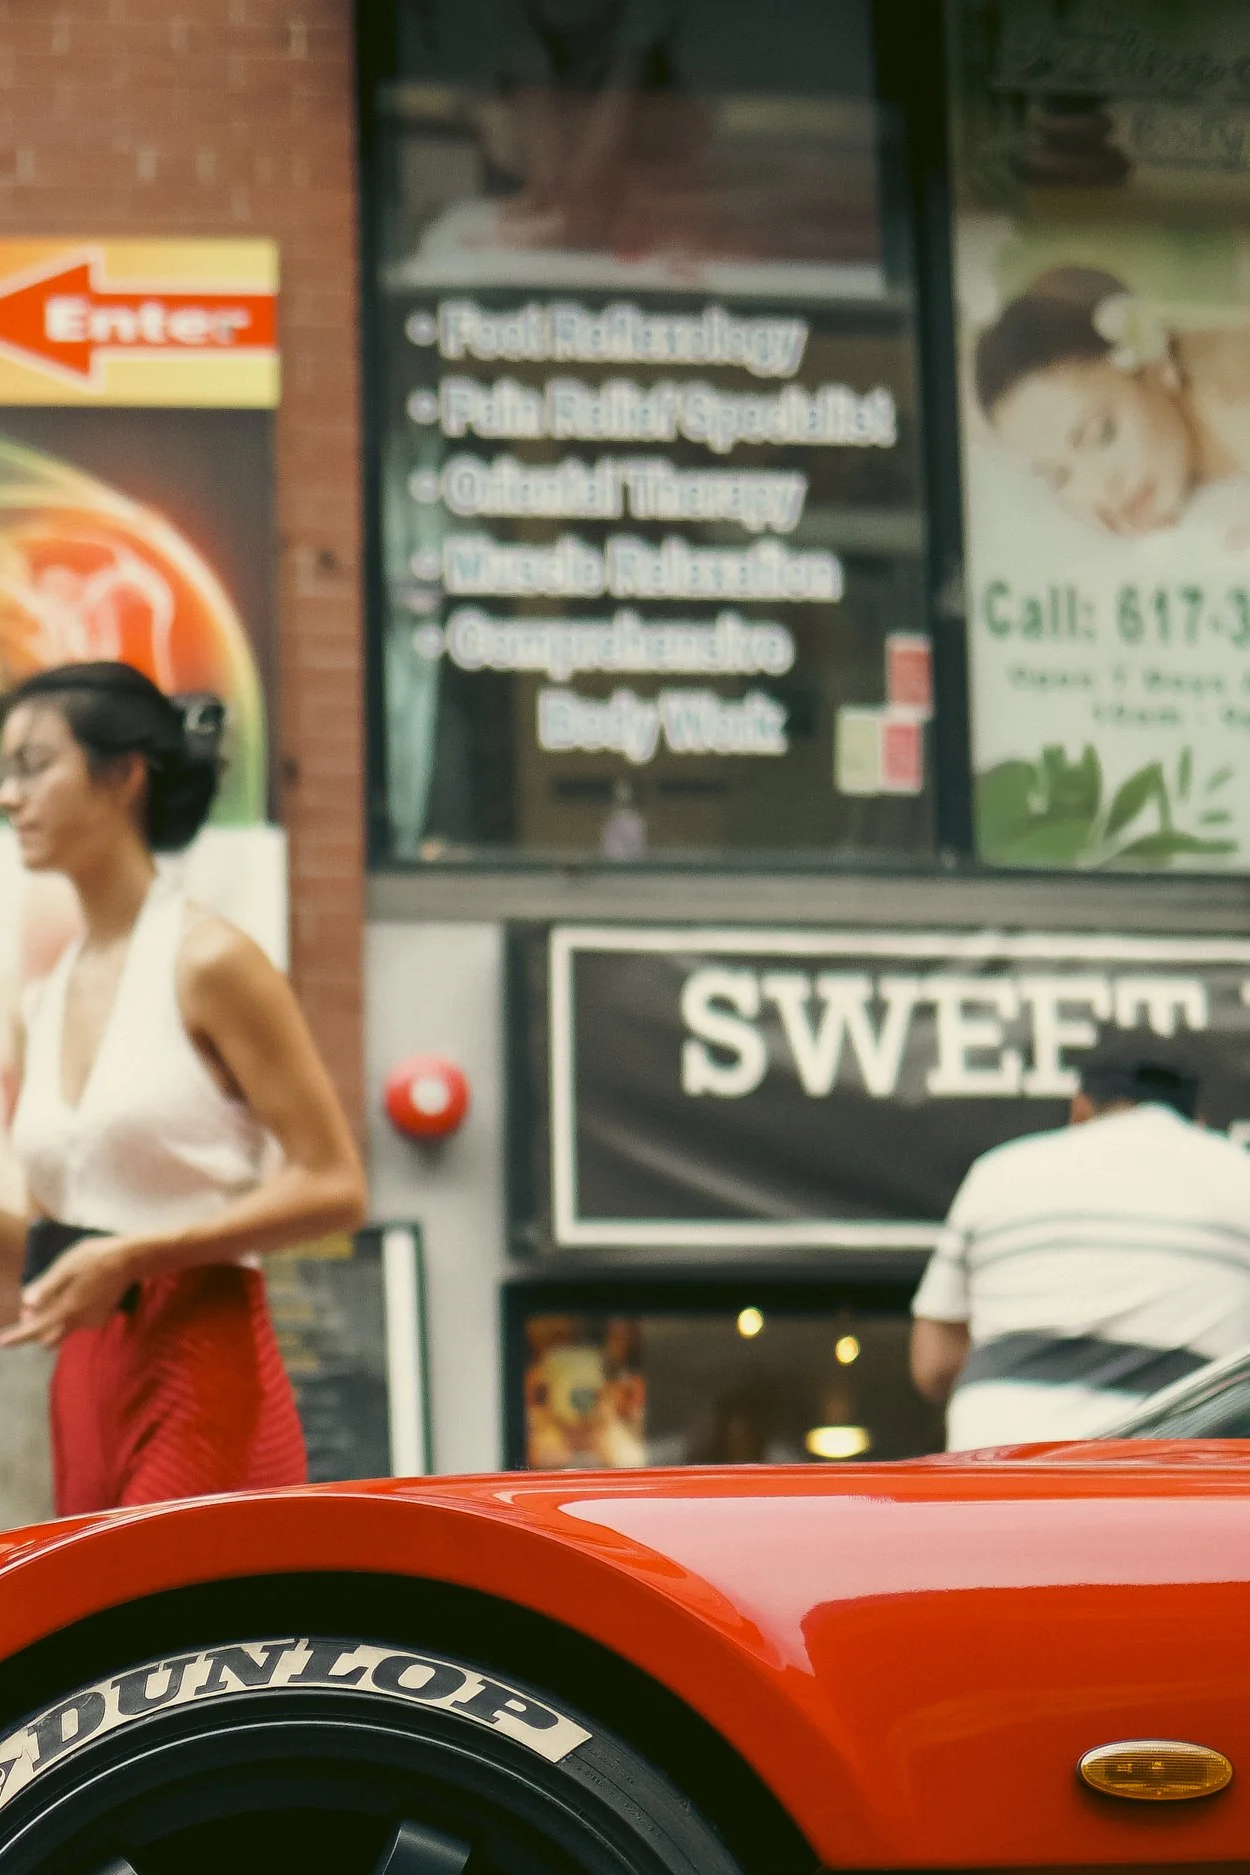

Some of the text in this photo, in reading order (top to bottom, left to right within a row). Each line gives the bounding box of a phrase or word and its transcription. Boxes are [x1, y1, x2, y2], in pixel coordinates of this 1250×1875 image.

[44, 296, 252, 344] Enter
[440, 302, 810, 378] Foot Reflexology
[440, 376, 897, 453] Pain Relief Specialist
[446, 454, 809, 533] Oriental Therapy
[445, 532, 843, 602] Muscle Relaxation
[985, 580, 1096, 642] Call:
[538, 687, 790, 764] Body Work
[27, 1638, 561, 1772] DUNLOP
